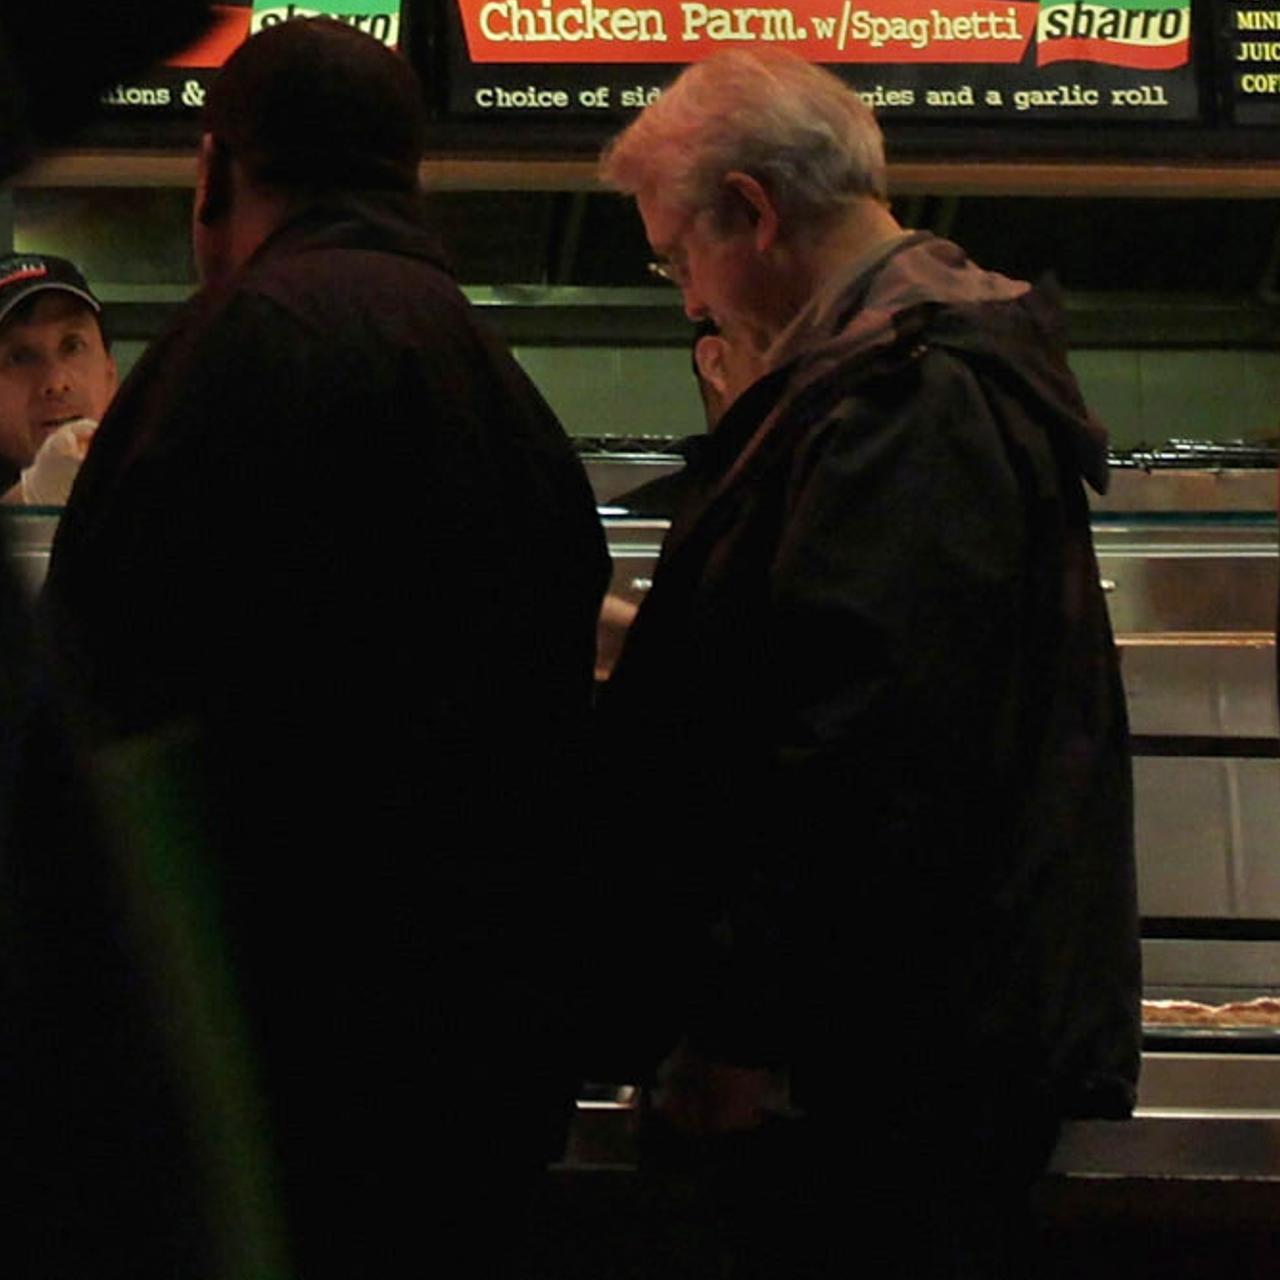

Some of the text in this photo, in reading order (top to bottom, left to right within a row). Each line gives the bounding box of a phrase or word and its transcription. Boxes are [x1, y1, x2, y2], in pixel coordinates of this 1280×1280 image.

[681, 0, 808, 42] Parm.
[812, 0, 1023, 51] w/Spaghetti
[1045, 0, 1183, 40] sbarro
[182, 80, 206, 107] &
[1240, 74, 1280, 93] COF
[475, 86, 569, 108] Choice
[579, 87, 609, 108] of
[926, 85, 974, 107] and
[985, 90, 1003, 106] a
[1013, 84, 1099, 111] garlic
[1111, 85, 1169, 106] roll
